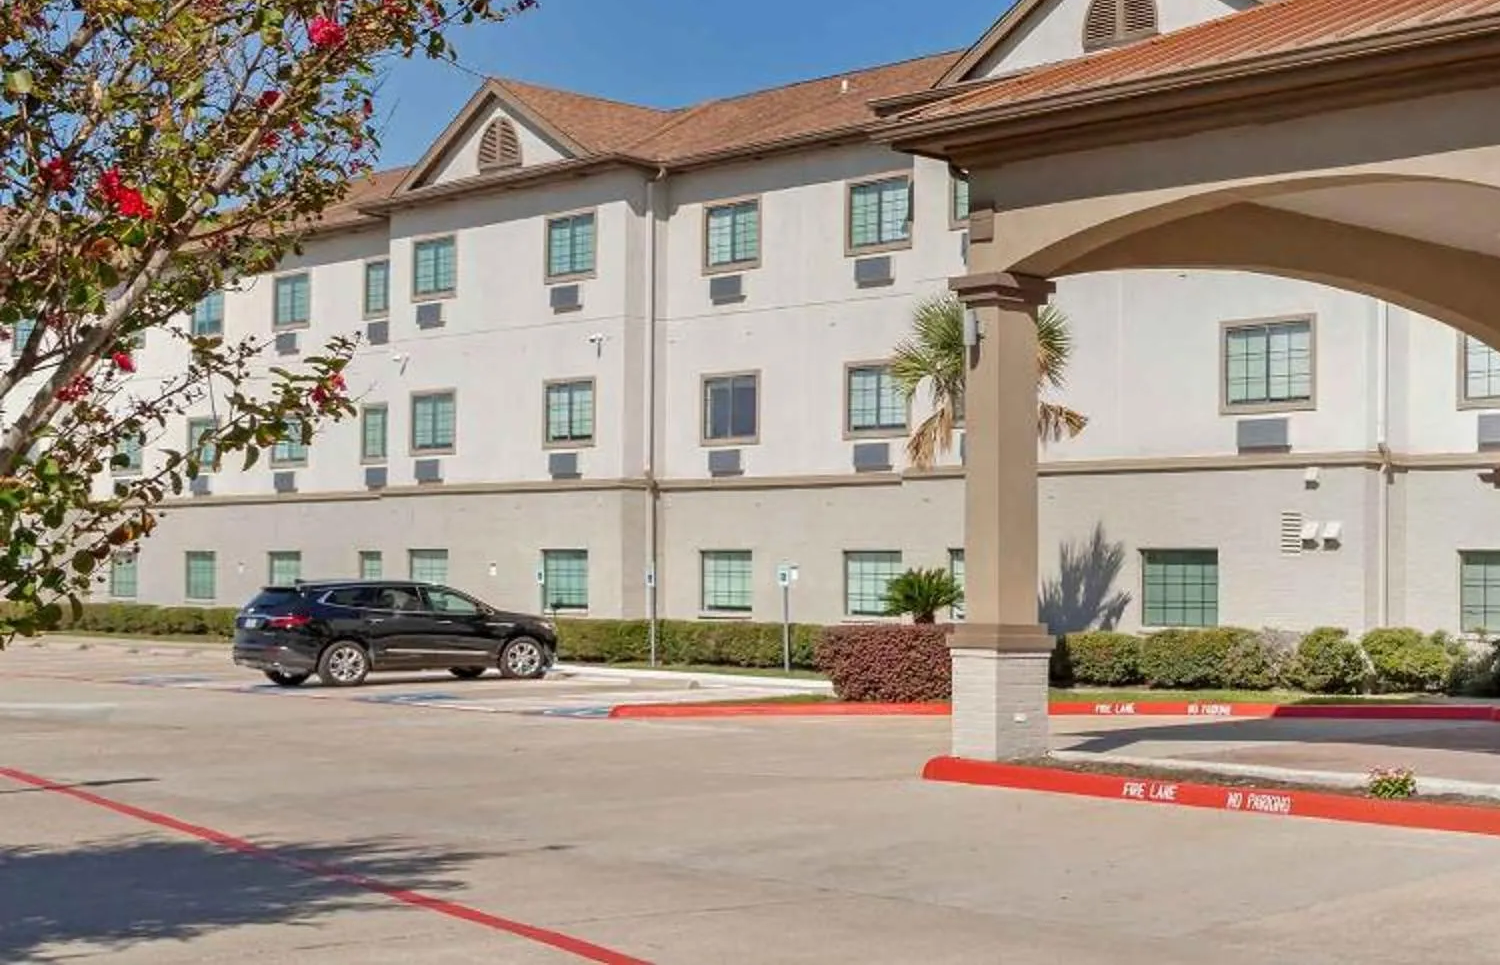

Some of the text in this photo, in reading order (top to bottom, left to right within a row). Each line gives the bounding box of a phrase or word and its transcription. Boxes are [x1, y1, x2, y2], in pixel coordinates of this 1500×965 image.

[1121, 781, 1178, 800] FIRE LANE
[1226, 792, 1292, 814] NO PARKING
